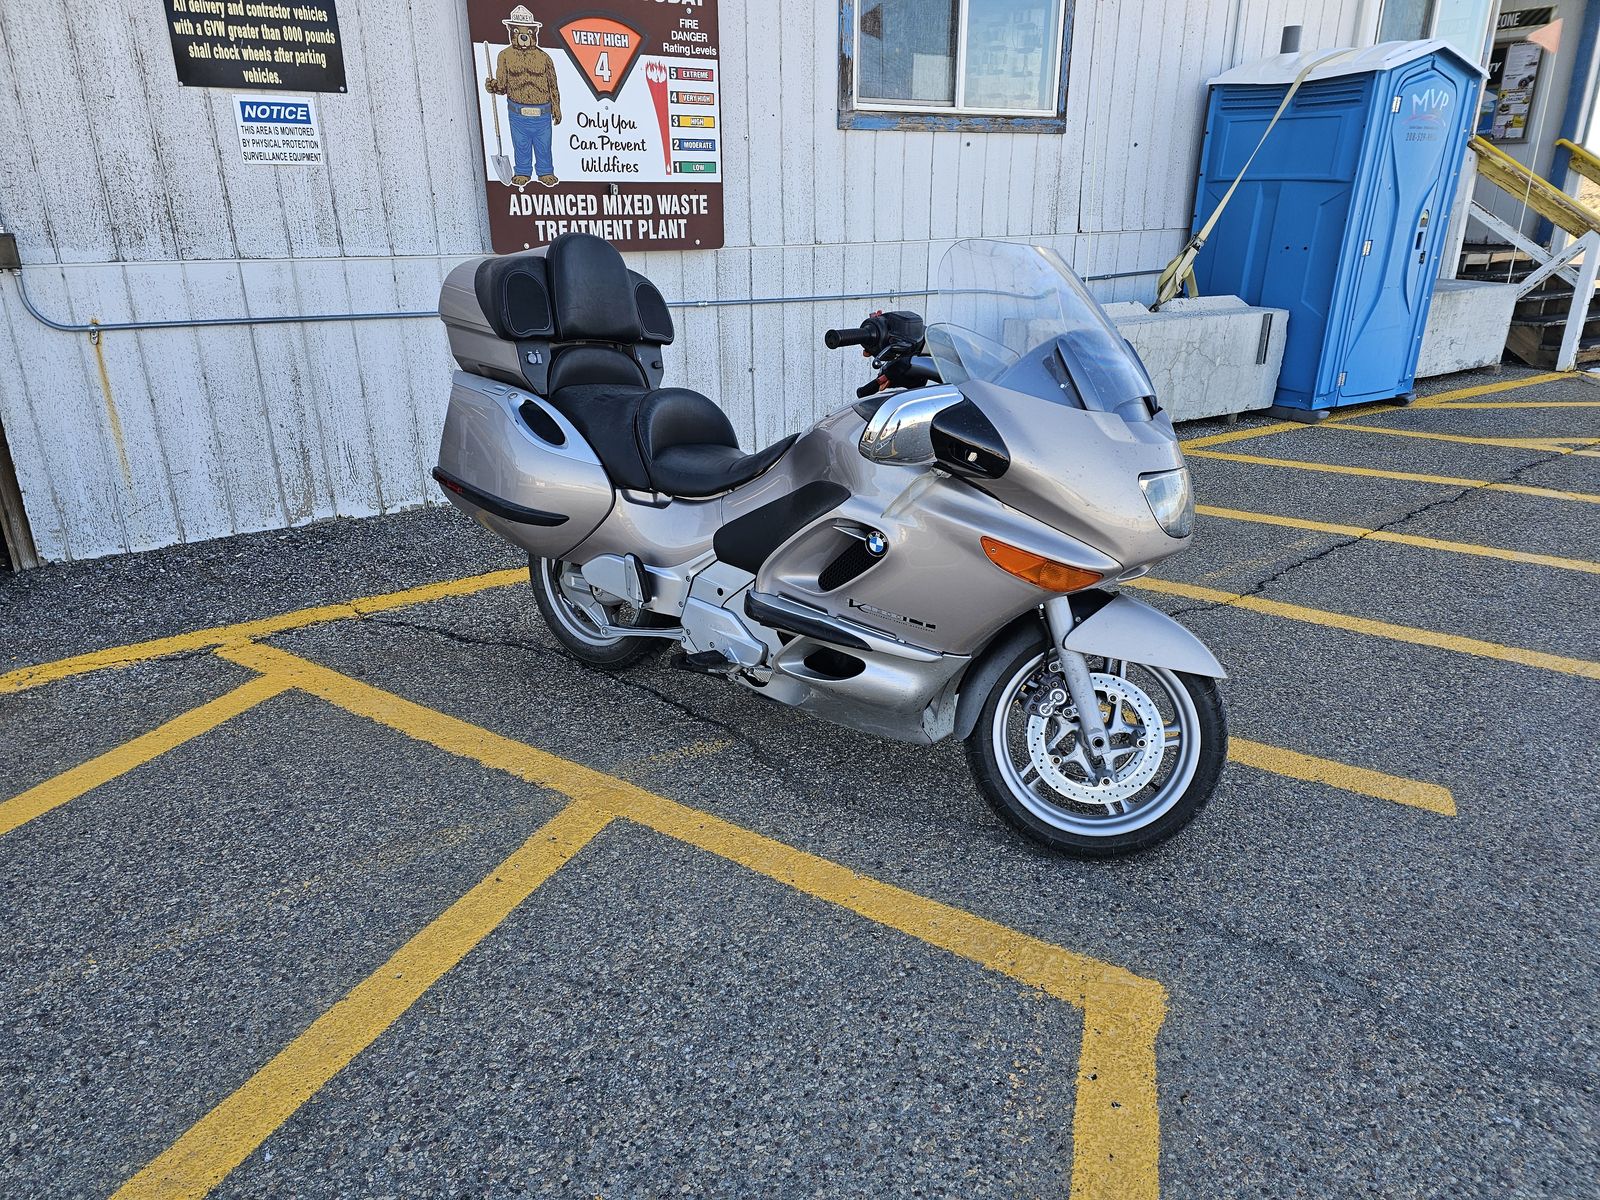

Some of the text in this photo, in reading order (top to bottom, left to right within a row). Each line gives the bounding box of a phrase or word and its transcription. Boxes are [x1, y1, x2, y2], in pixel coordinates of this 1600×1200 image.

[173, 0, 328, 22] All delivery and contractor vehicles
[679, 18, 699, 29] FIRE
[173, 19, 336, 45] with a GVW greater than 8000 pounds
[572, 30, 629, 48] VERY HIGH
[671, 30, 708, 42] DANGER
[188, 42, 327, 68] shall chock wheels after parking
[662, 42, 717, 56] Rating Levels
[595, 52, 611, 82] 4
[670, 67, 709, 79] 5 EXTREME
[243, 68, 283, 84] vehicles.
[671, 92, 678, 103] 4
[682, 94, 697, 102] VERY
[1412, 88, 1450, 115] MVP
[244, 104, 308, 120] NOTICE
[576, 111, 638, 134] Only You
[672, 115, 679, 126] 3
[241, 125, 315, 136] THIS AREA IS MONITORED
[242, 139, 319, 149] BY PHYSICAL PROTECTION
[569, 133, 647, 151] Can Prevent
[673, 139, 713, 150] 2 MODERATE
[243, 151, 321, 162] SURVEILLANCE EQUIPMENT
[581, 155, 639, 173] Wildfires
[674, 162, 680, 173] 1
[509, 194, 709, 216] ADVANCED MIXED WASTE
[534, 218, 688, 242] TREATMENT PLANT
